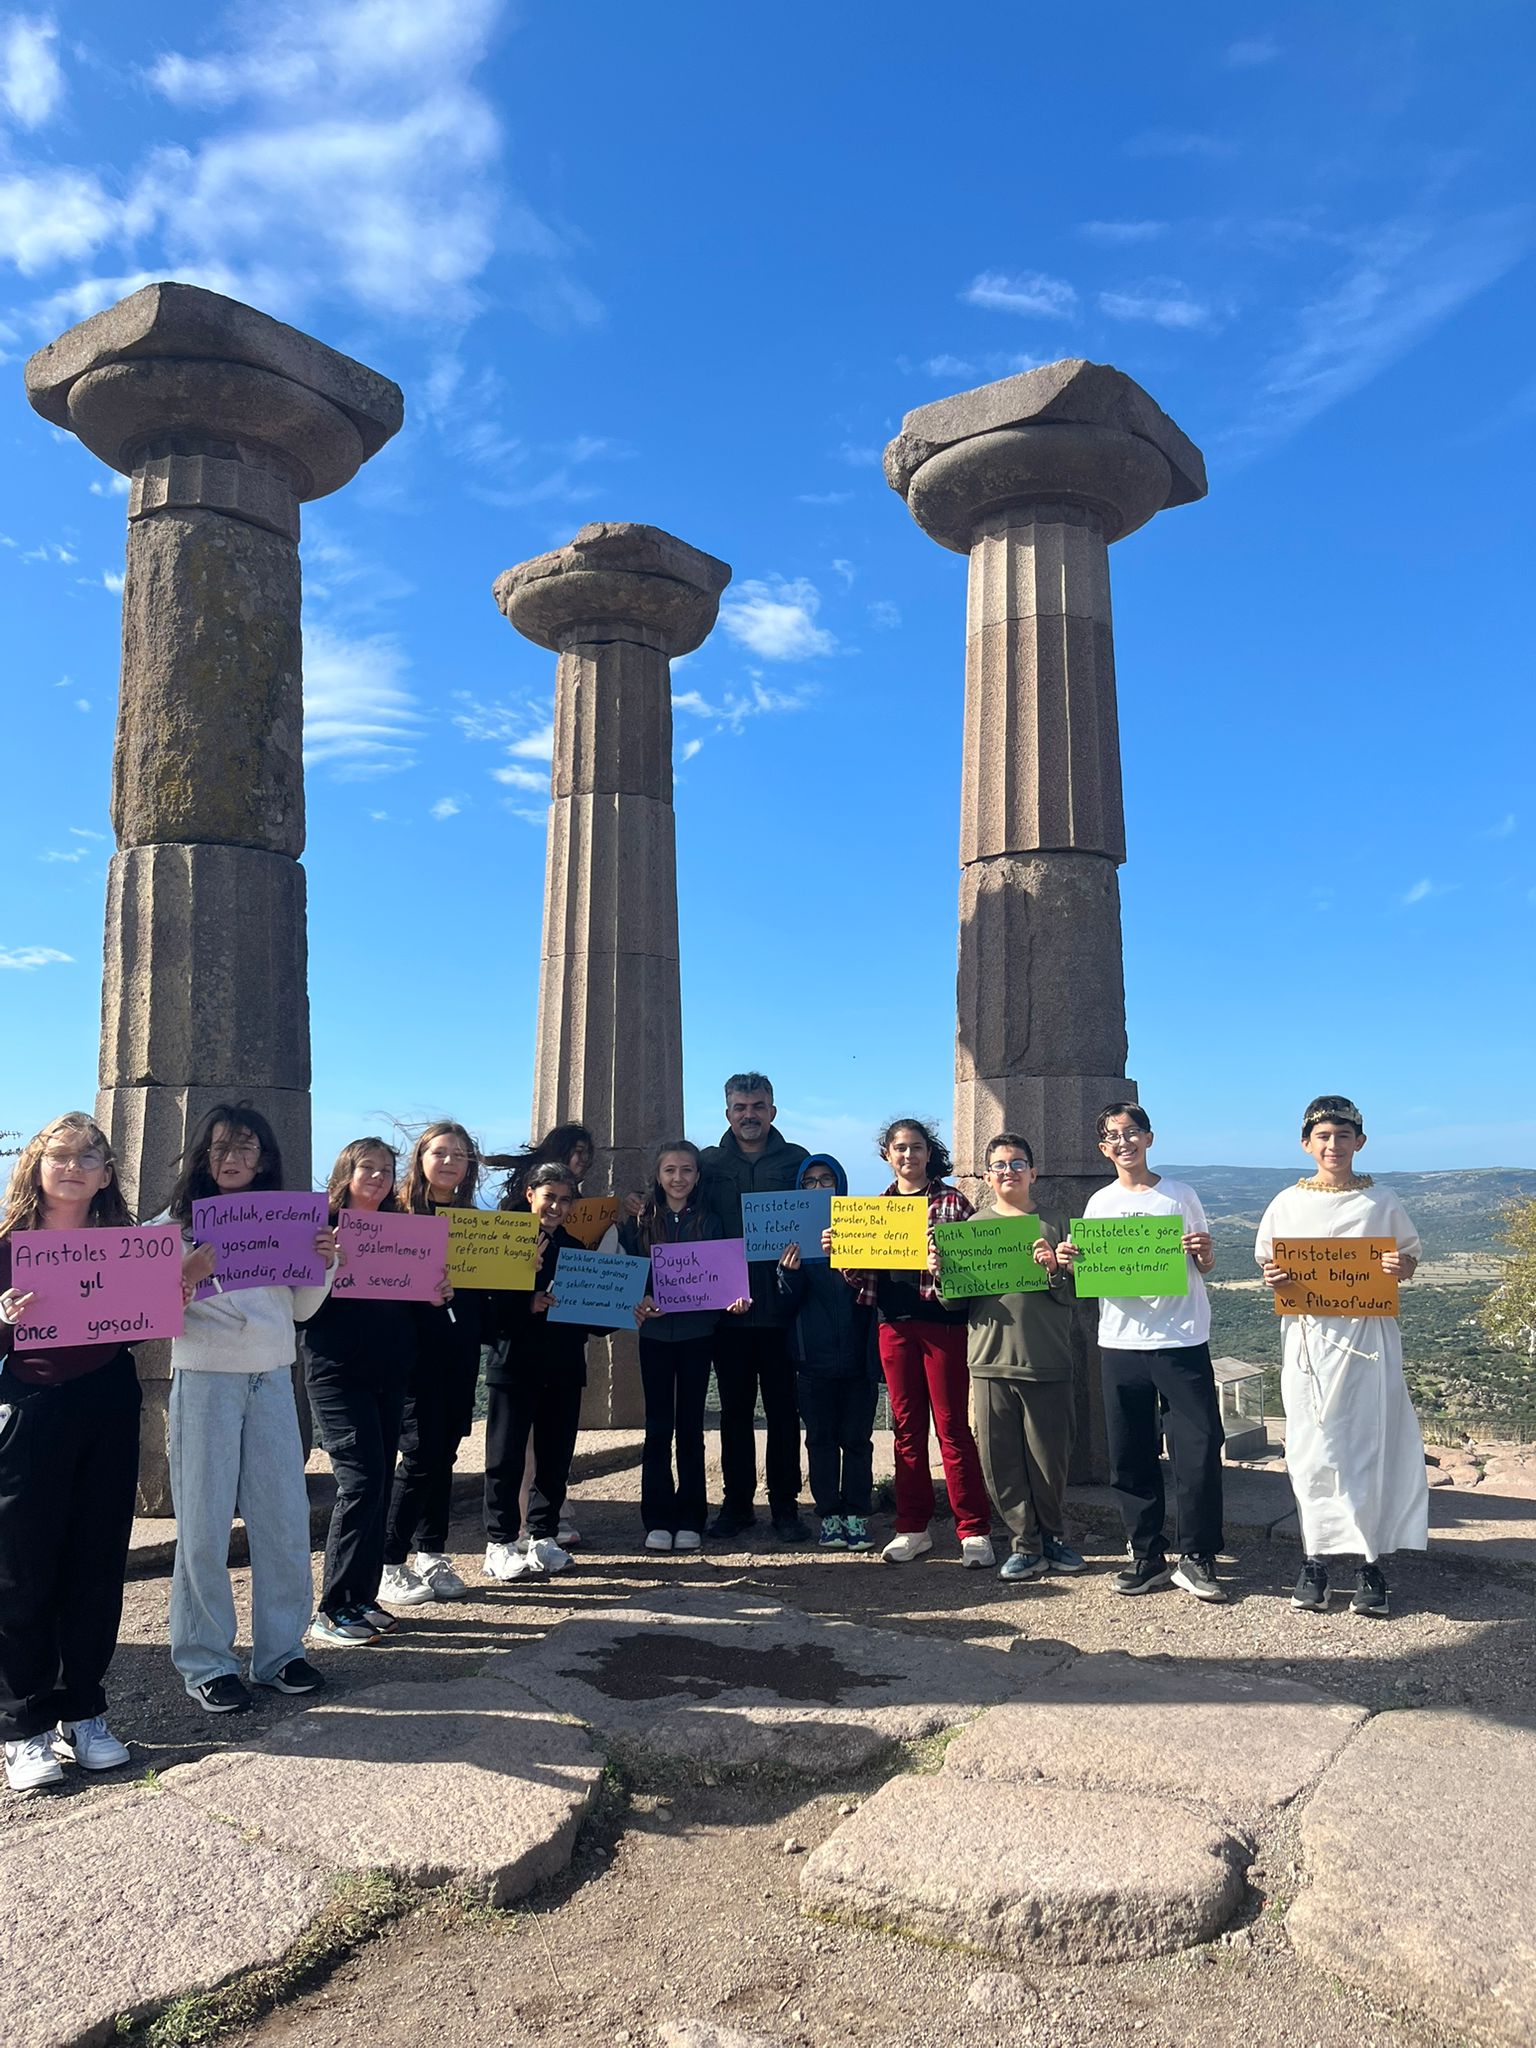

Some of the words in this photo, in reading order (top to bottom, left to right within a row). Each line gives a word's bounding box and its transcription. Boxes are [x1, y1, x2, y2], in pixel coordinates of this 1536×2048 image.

[194, 1204, 263, 1231] Mutluluk,
[265, 1206, 322, 1223] erdemli
[341, 1212, 383, 1239] Doğayı
[765, 1220, 800, 1233] felsefe
[884, 1230, 909, 1240] derin
[971, 1226, 1002, 1239] Yunan
[16, 1244, 107, 1268] Aristoles
[119, 1236, 174, 1260] 2300
[221, 1235, 280, 1259] yaşamla
[456, 1243, 500, 1255] referans
[997, 1241, 1034, 1256] mantığ
[1137, 1245, 1149, 1254] en
[1275, 1242, 1357, 1261] Aristoteles
[653, 1246, 700, 1272] Büyük
[1077, 1263, 1116, 1278] problem
[80, 1272, 105, 1298] yıl
[334, 1273, 356, 1290] çok
[1281, 1298, 1297, 1308] ve
[1305, 1291, 1392, 1310] filozofudur.
[15, 1324, 59, 1342] önce
[86, 1312, 154, 1340] yaşadı.
